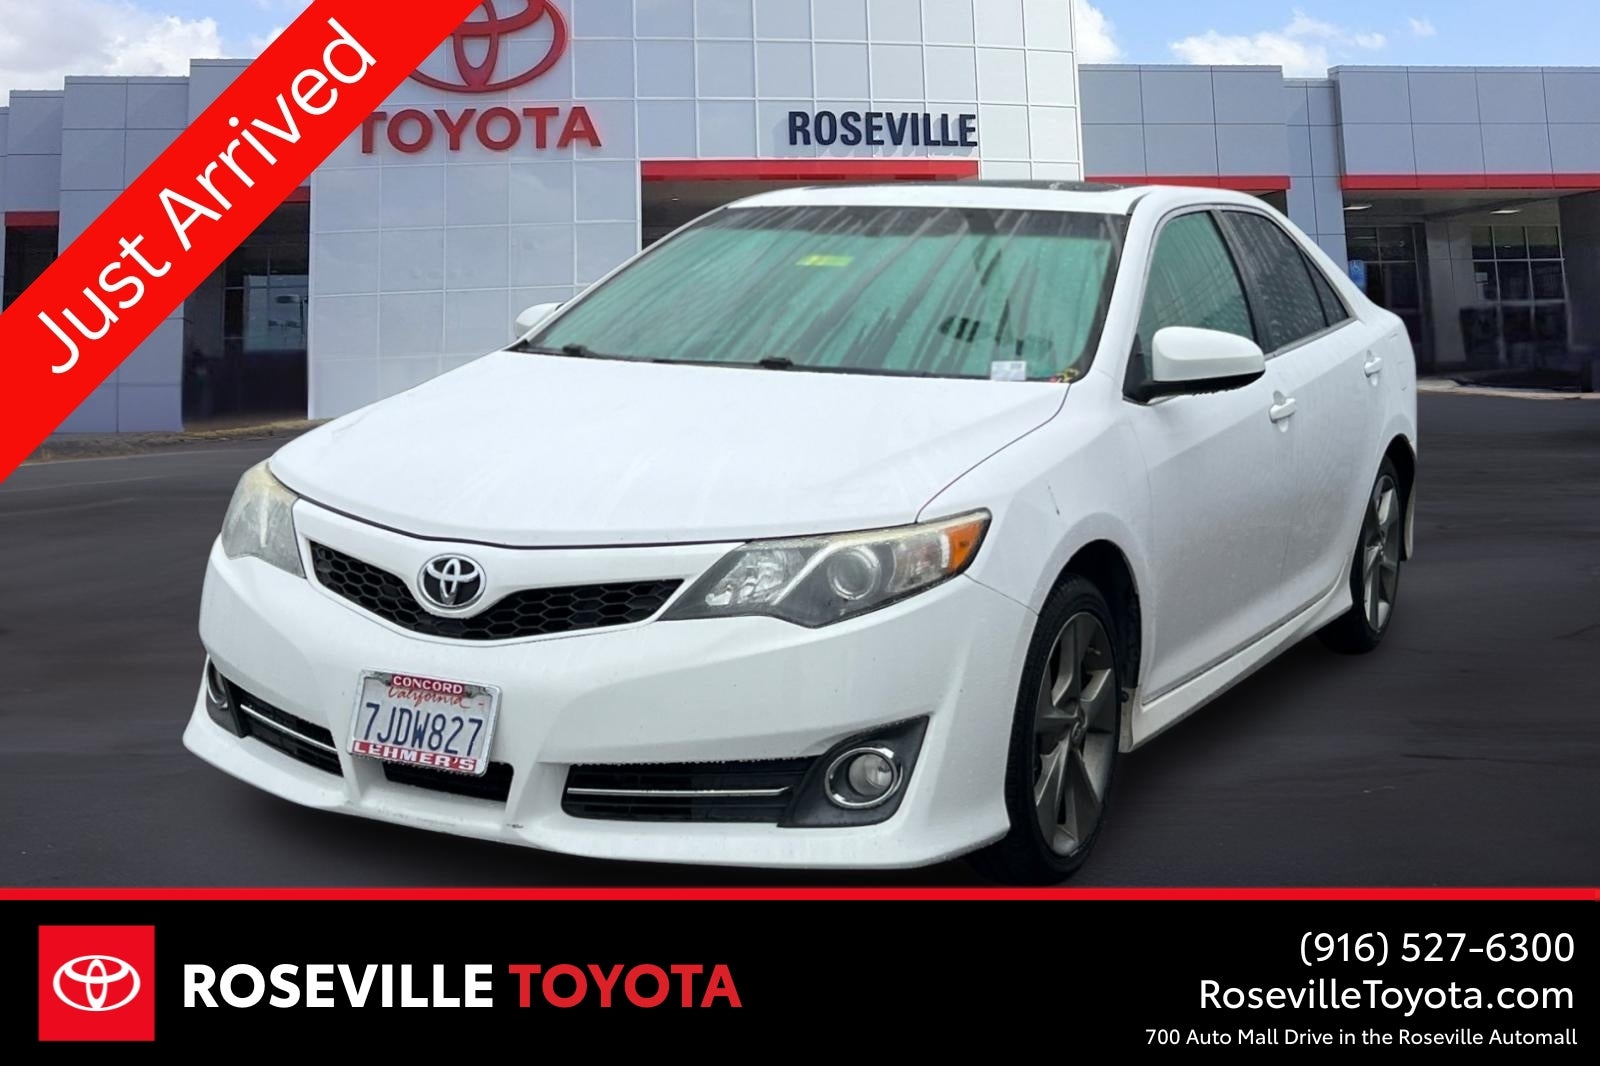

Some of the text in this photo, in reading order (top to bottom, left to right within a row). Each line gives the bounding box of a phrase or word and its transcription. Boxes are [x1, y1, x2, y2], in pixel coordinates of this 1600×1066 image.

[361, 106, 602, 153] TOYOTA
[788, 111, 978, 147] ROSEVILLE
[392, 675, 464, 695] CONCORD
[363, 702, 483, 757] 7JDW827
[354, 741, 475, 771] LEHMER'S
